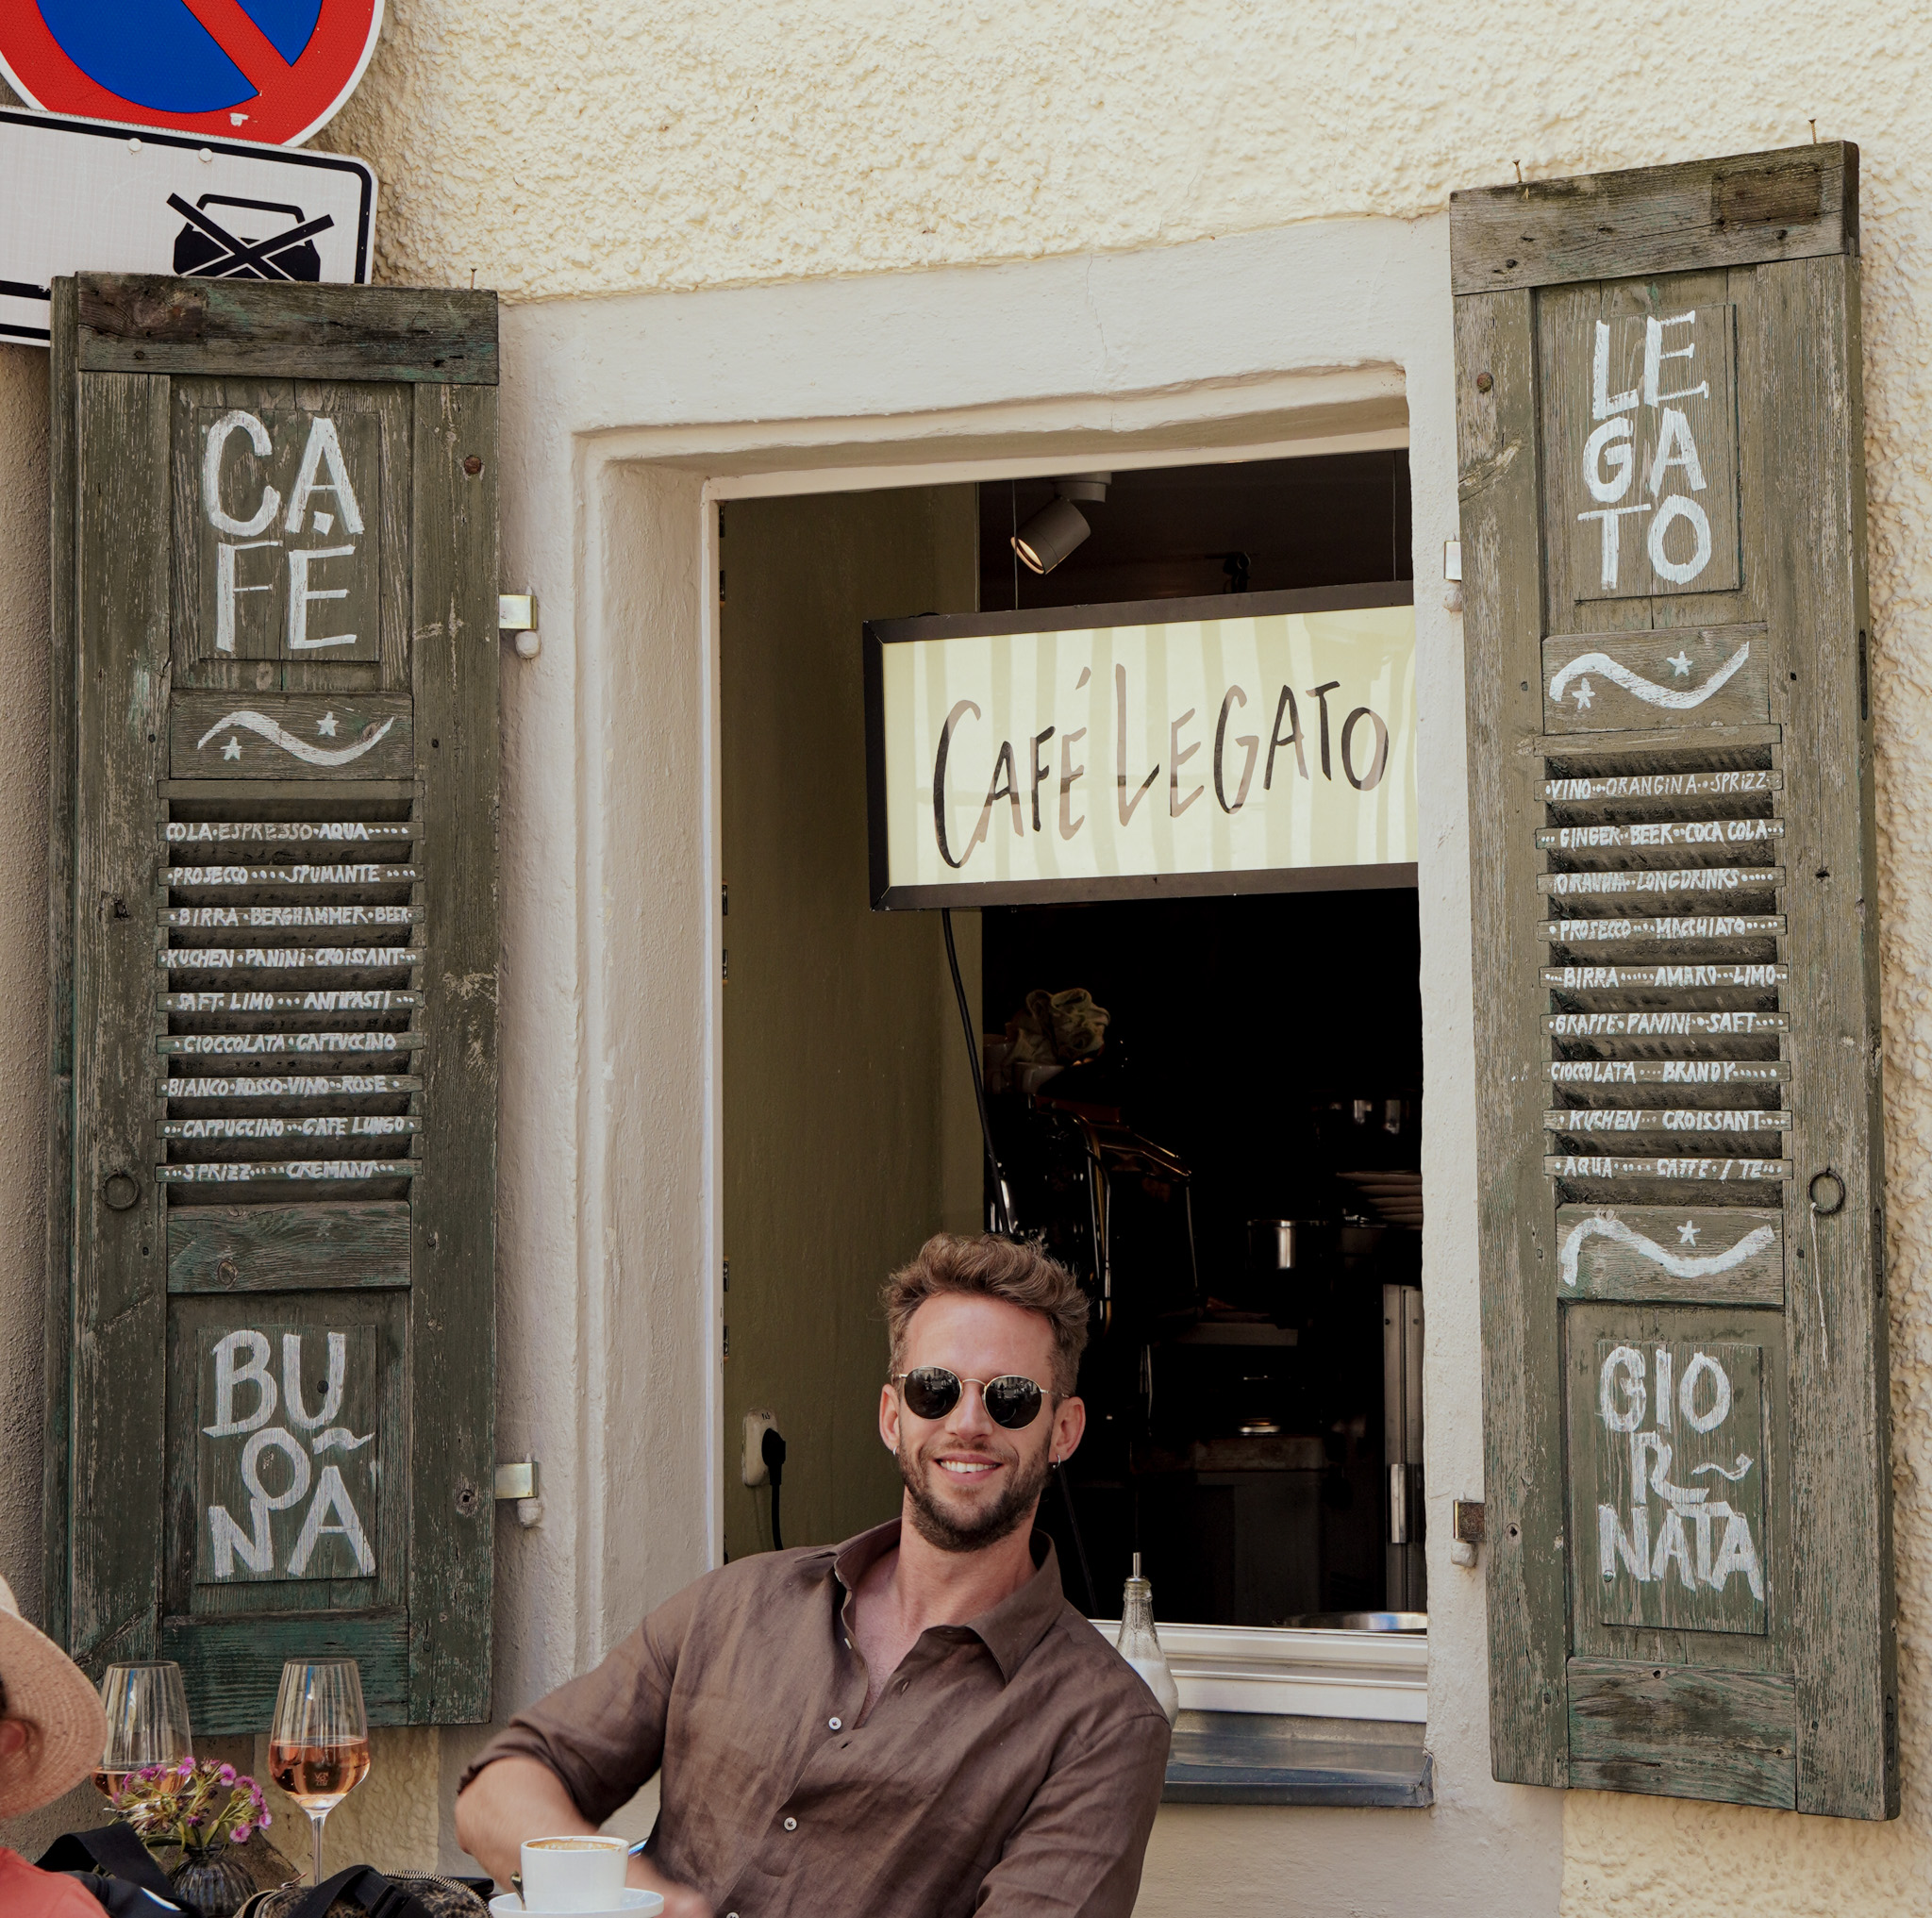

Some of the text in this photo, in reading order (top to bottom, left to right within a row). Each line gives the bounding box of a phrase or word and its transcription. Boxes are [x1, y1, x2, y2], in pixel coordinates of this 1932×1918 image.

[1592, 310, 1708, 420] LE
[1583, 407, 1707, 503] GA
[203, 410, 364, 536] CA
[1577, 494, 1712, 590] TO
[216, 541, 356, 652] FE
[933, 663, 1389, 869] CAFÉ LEGATO
[1551, 779, 1591, 800] VINO
[166, 823, 370, 841] COLA ESPRESSO AQUA
[1560, 820, 1768, 849] GINGER BEER COCA COLA
[173, 864, 380, 885] PROSECCO SPUMANTE
[1637, 869, 1740, 893] LONGDRINKS
[178, 906, 409, 926] BIRRA BERGHAMMER BEER
[1559, 918, 1745, 942] PROSECCO MACCHIATO
[166, 949, 234, 968] KUCHEN
[1564, 965, 1776, 990] BIRRA AMARO LIMO
[176, 993, 225, 1012] SAFT
[229, 992, 274, 1010] LIMO
[1626, 1013, 1690, 1036] PANINI
[1707, 1012, 1757, 1033] SAFT
[184, 1033, 397, 1053] CIOCCOLATA CAPPUCCINO
[1662, 1061, 1737, 1083] BRANDY
[168, 1075, 388, 1097] BIANCO ROSSO VINO ROSE
[183, 1116, 405, 1138] CAPPUCCINO CAFE LUNGO
[1569, 1109, 1766, 1132] KUCHEN CROISSANT
[183, 1160, 376, 1181] SPRIZZ CREMANT
[1563, 1157, 1613, 1178] AQUA
[202, 1329, 345, 1438] BU
[1600, 1345, 1731, 1434] GIO
[1598, 1501, 1764, 1602] NATA
